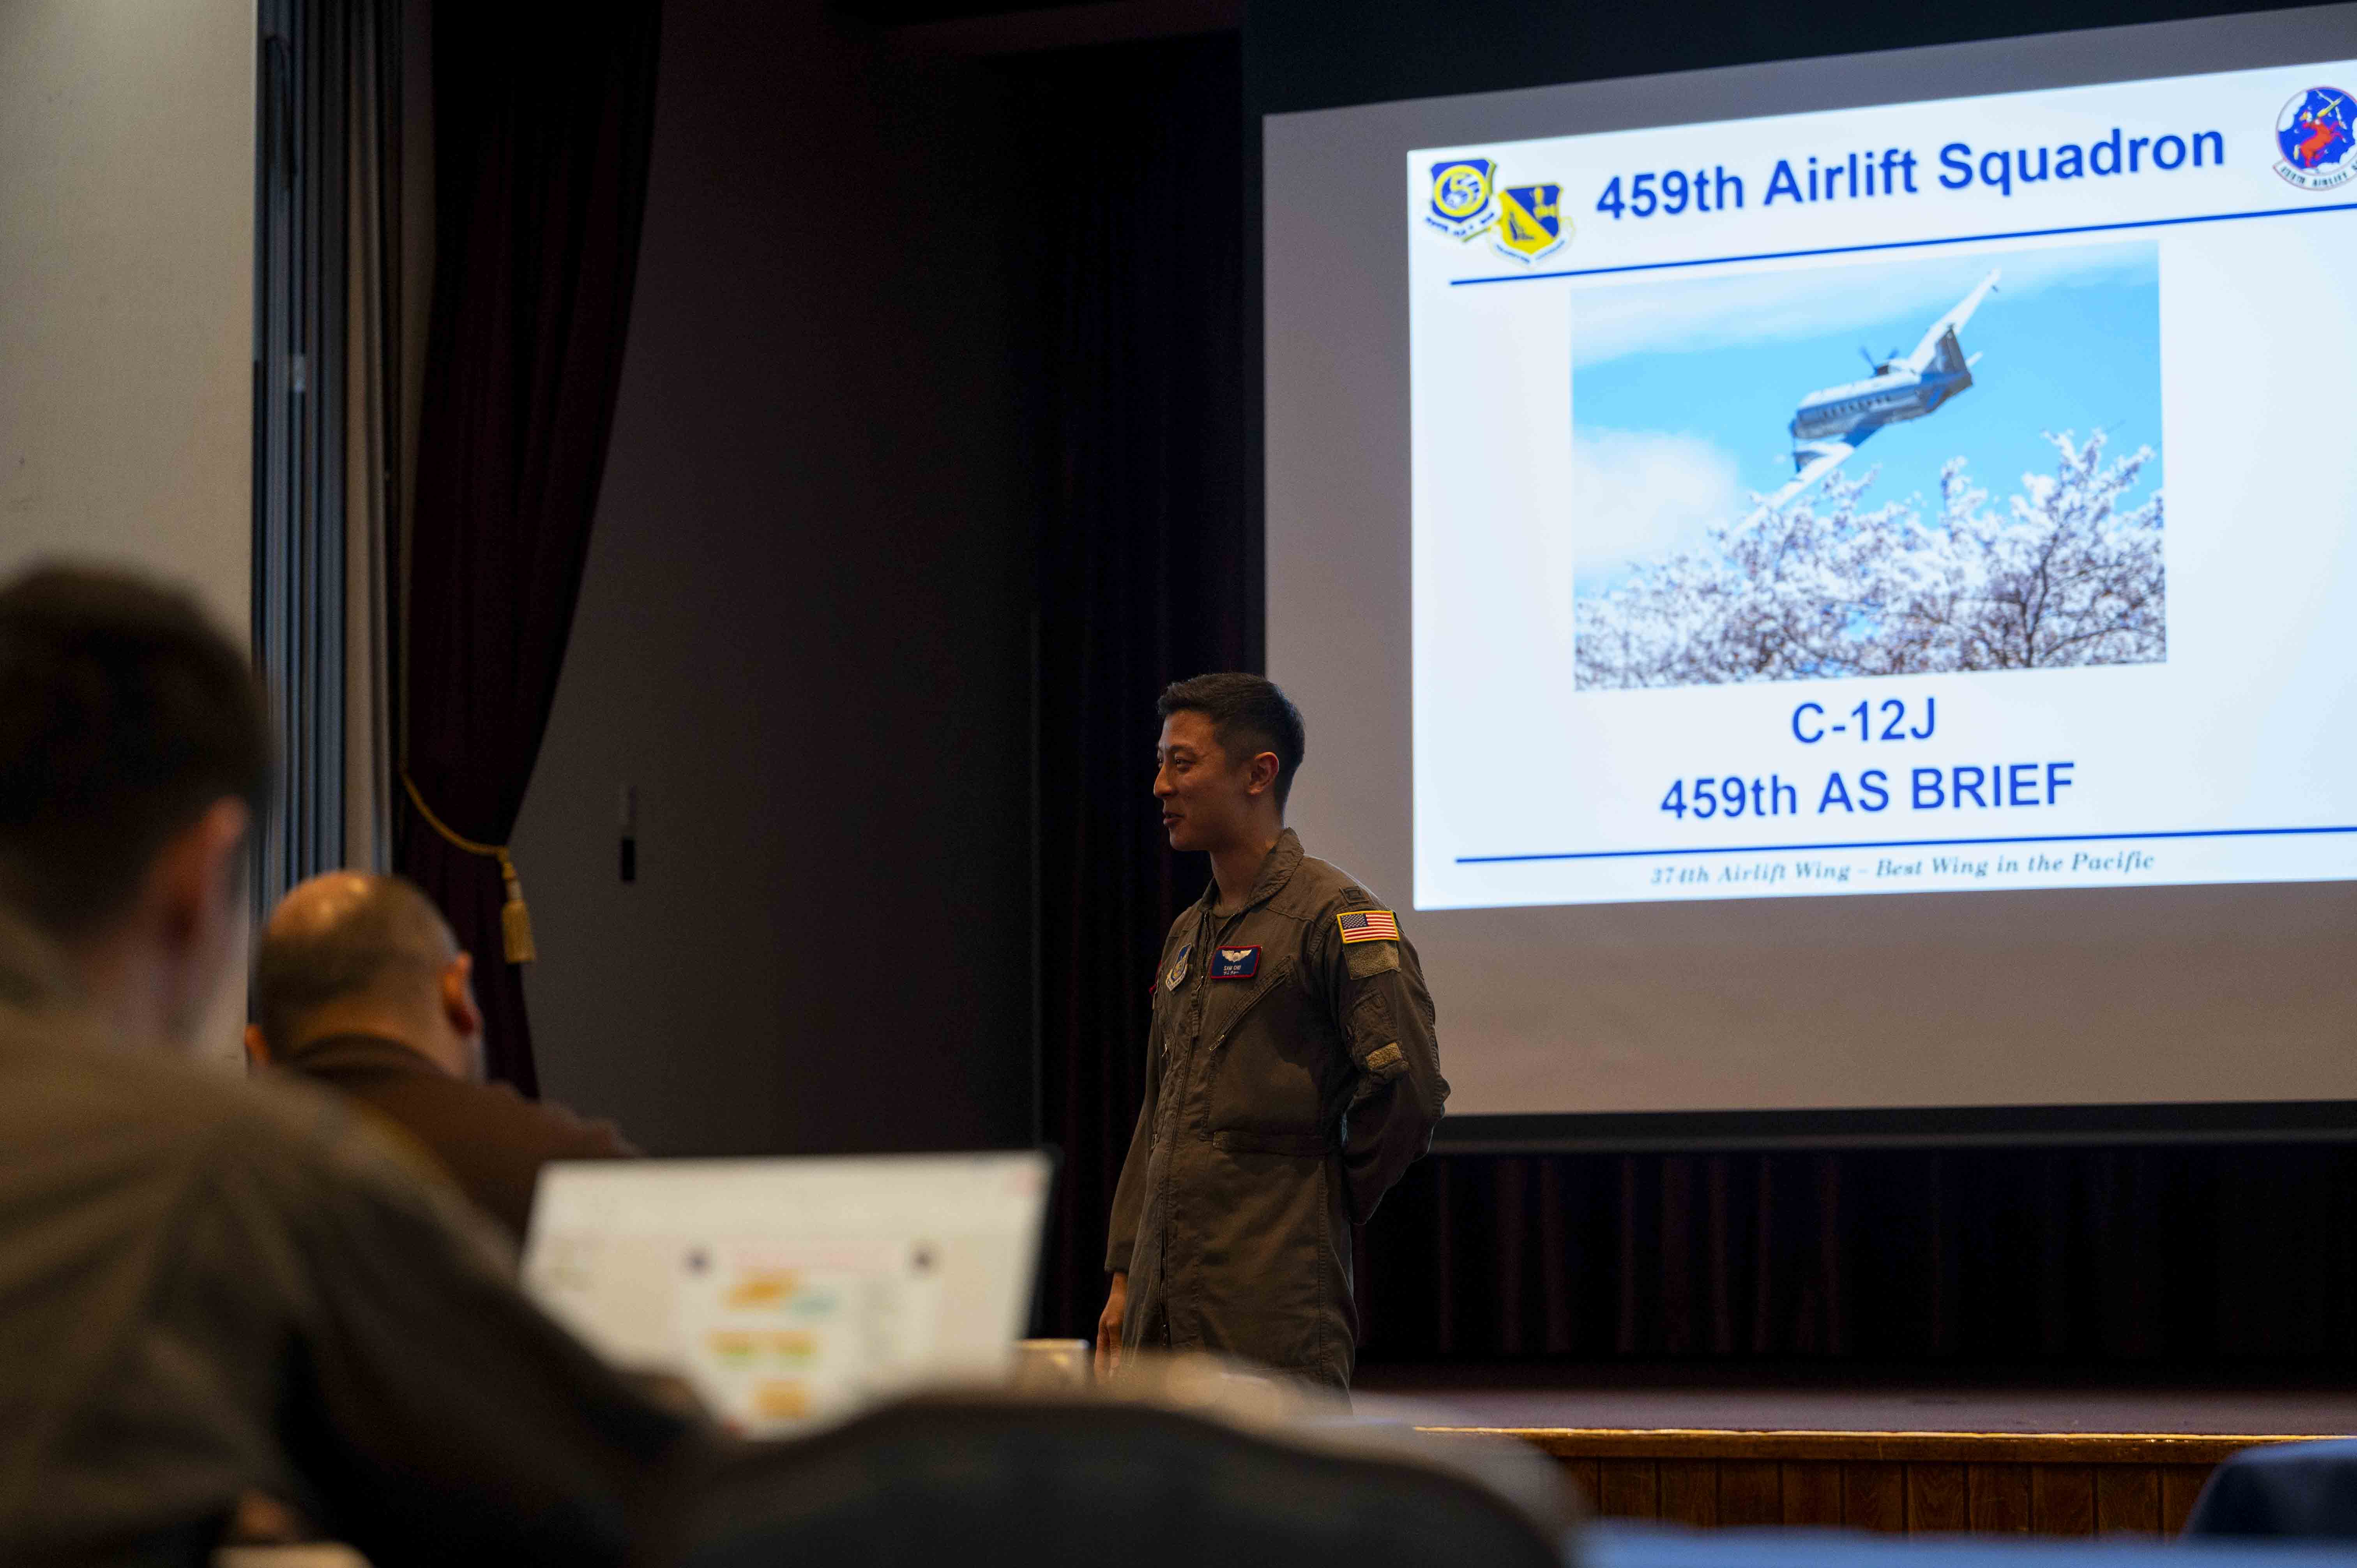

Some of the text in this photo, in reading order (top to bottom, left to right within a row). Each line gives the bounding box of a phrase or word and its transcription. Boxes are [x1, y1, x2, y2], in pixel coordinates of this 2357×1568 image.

[1595, 127, 2225, 221] 459th Airlift Squadron
[1792, 696, 1935, 744] C-12J
[1660, 761, 2076, 820] 459th AS BRIEF
[1651, 865, 1709, 885] 374th
[1718, 862, 1786, 884] Airlift
[1795, 861, 1850, 881] Wing
[1875, 858, 1922, 877] Best
[1932, 856, 1989, 877] Wing
[1998, 855, 2019, 873] in
[2028, 853, 2064, 872] the
[2071, 850, 2155, 873] Pacific
